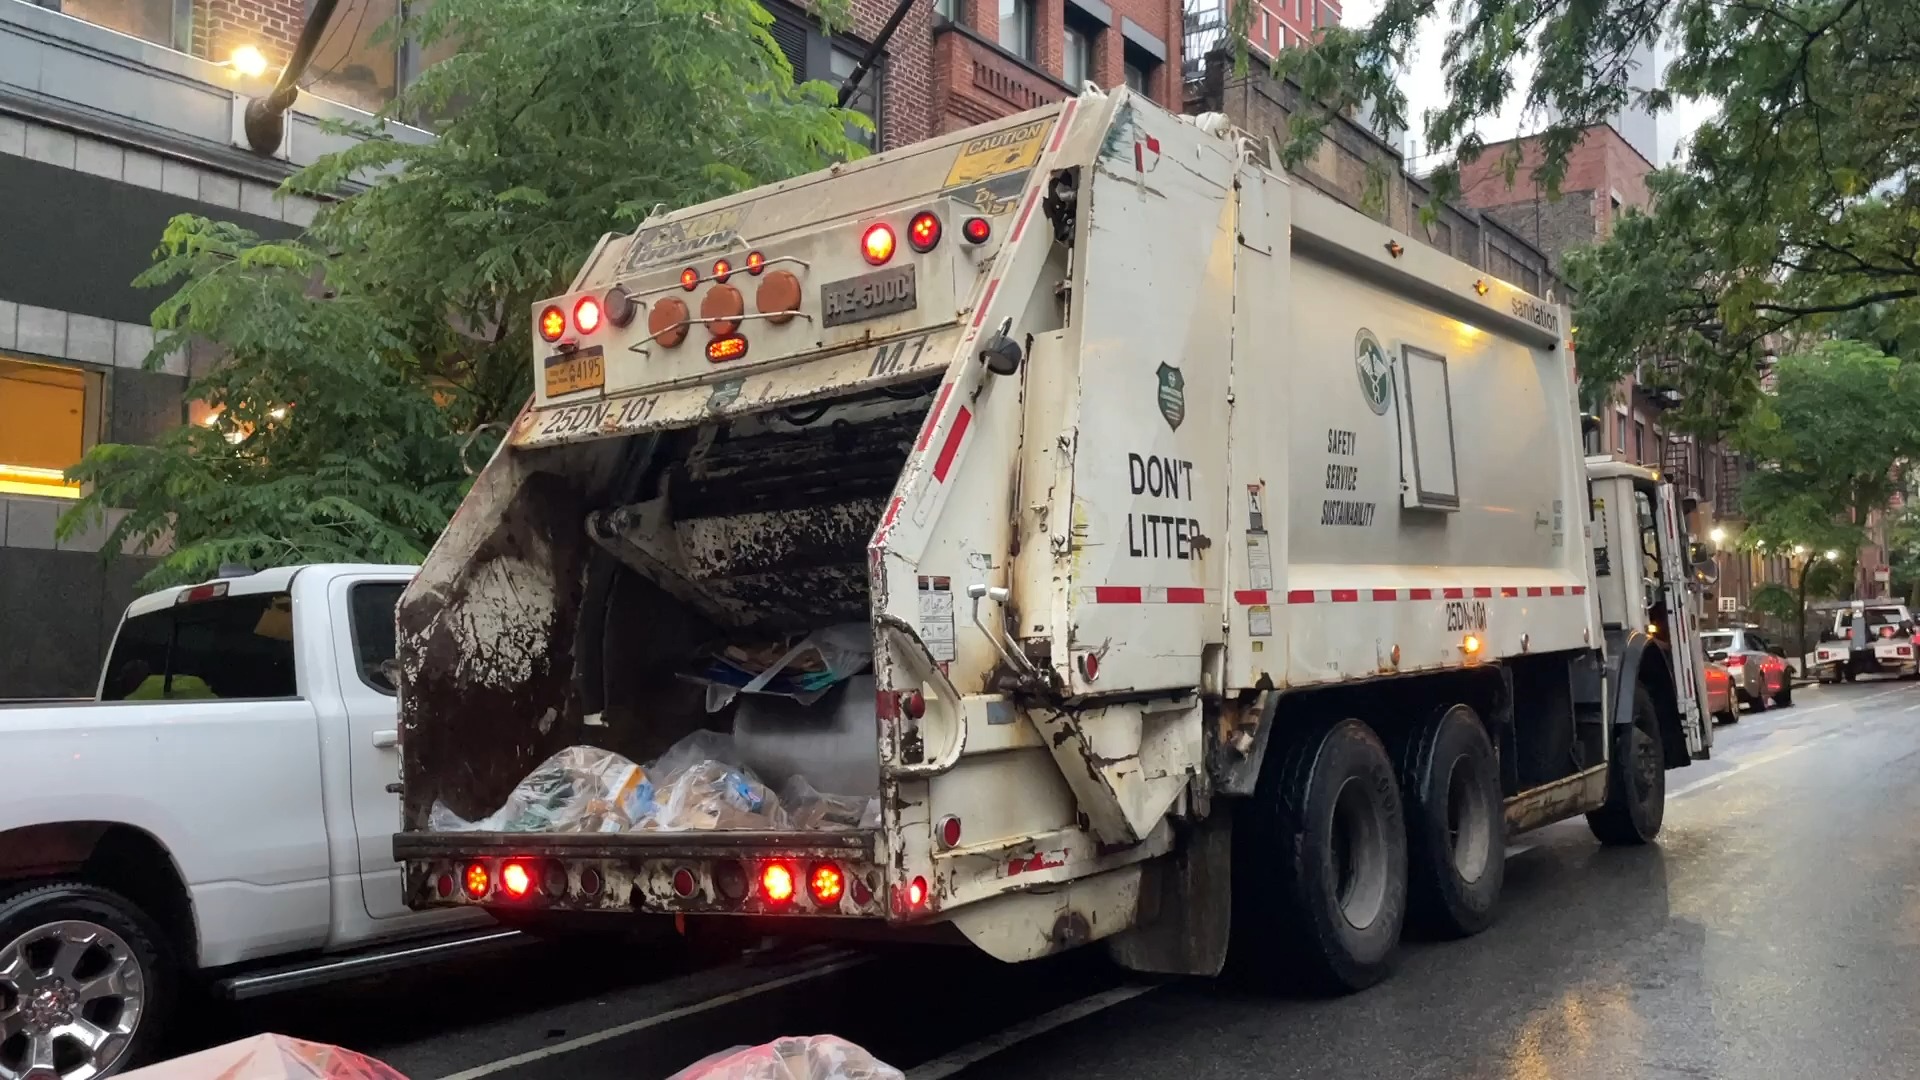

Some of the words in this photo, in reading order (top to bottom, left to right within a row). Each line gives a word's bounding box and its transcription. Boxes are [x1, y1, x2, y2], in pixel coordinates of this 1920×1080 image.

[967, 125, 1041, 154] CAUTION
[1511, 296, 1559, 333] sanitation
[541, 395, 660, 436] 25DN-101
[1327, 427, 1357, 457] SAFETY
[1127, 452, 1193, 502] DON'T
[1325, 463, 1358, 492] SERVICE
[1320, 499, 1377, 528] SUSTAINABILITY
[1127, 512, 1204, 561] LITTER
[1446, 600, 1488, 633] 25DN-101
